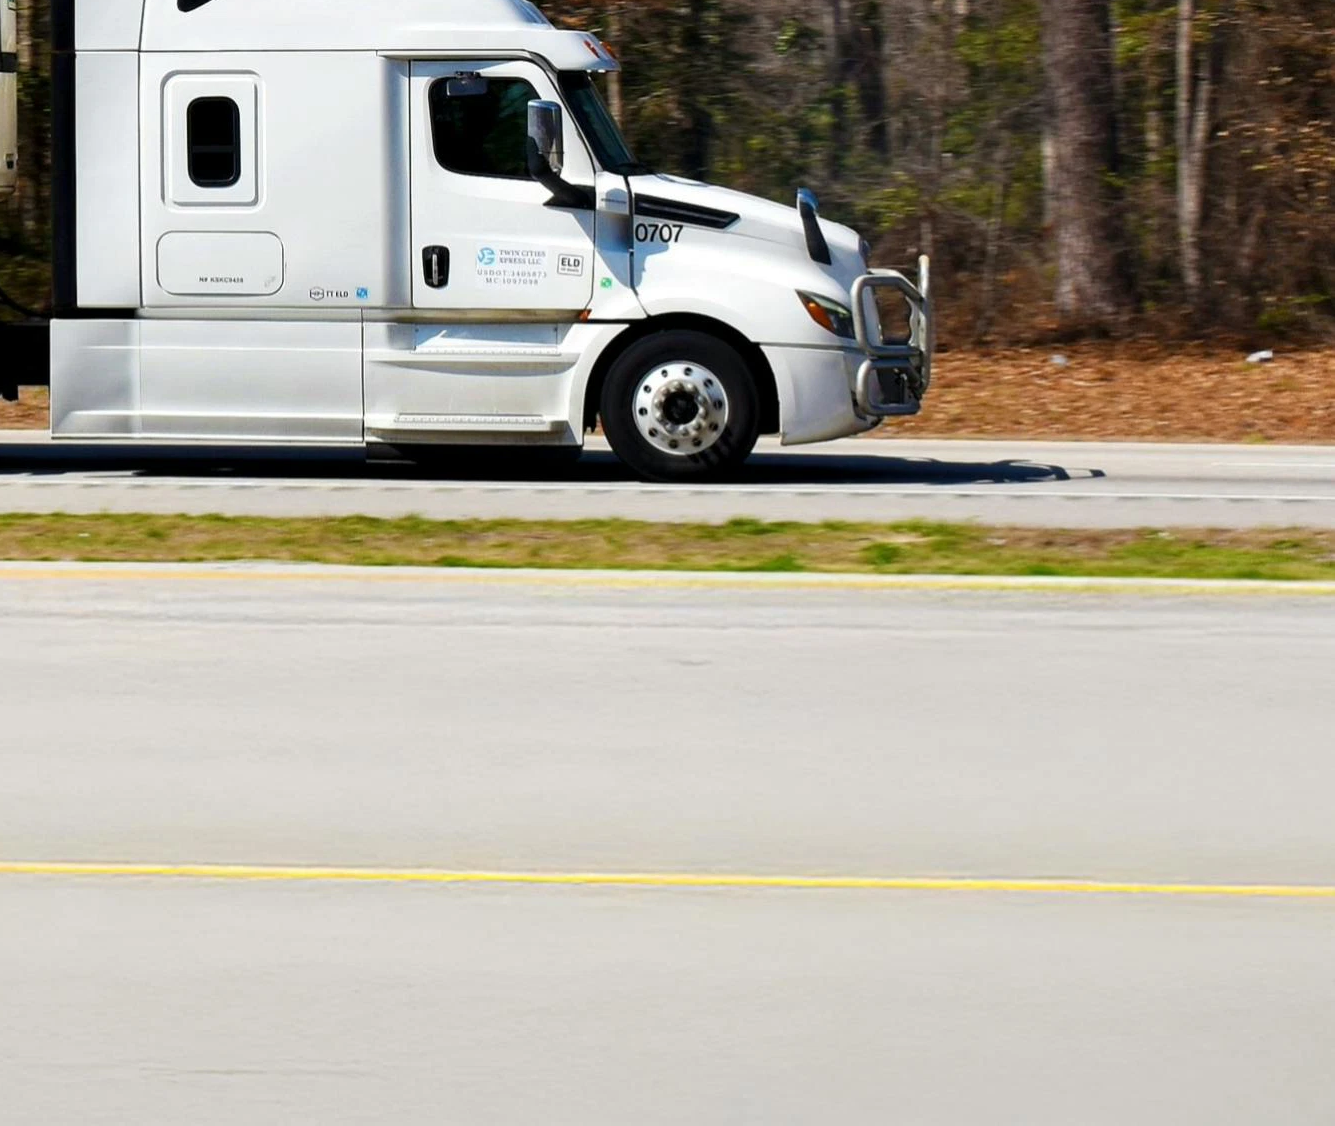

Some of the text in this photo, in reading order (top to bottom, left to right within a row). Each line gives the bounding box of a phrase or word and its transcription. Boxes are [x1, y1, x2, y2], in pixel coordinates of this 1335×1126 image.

[634, 223, 684, 243] 0707
[561, 257, 581, 267] ELD
[335, 290, 349, 298] ELD
